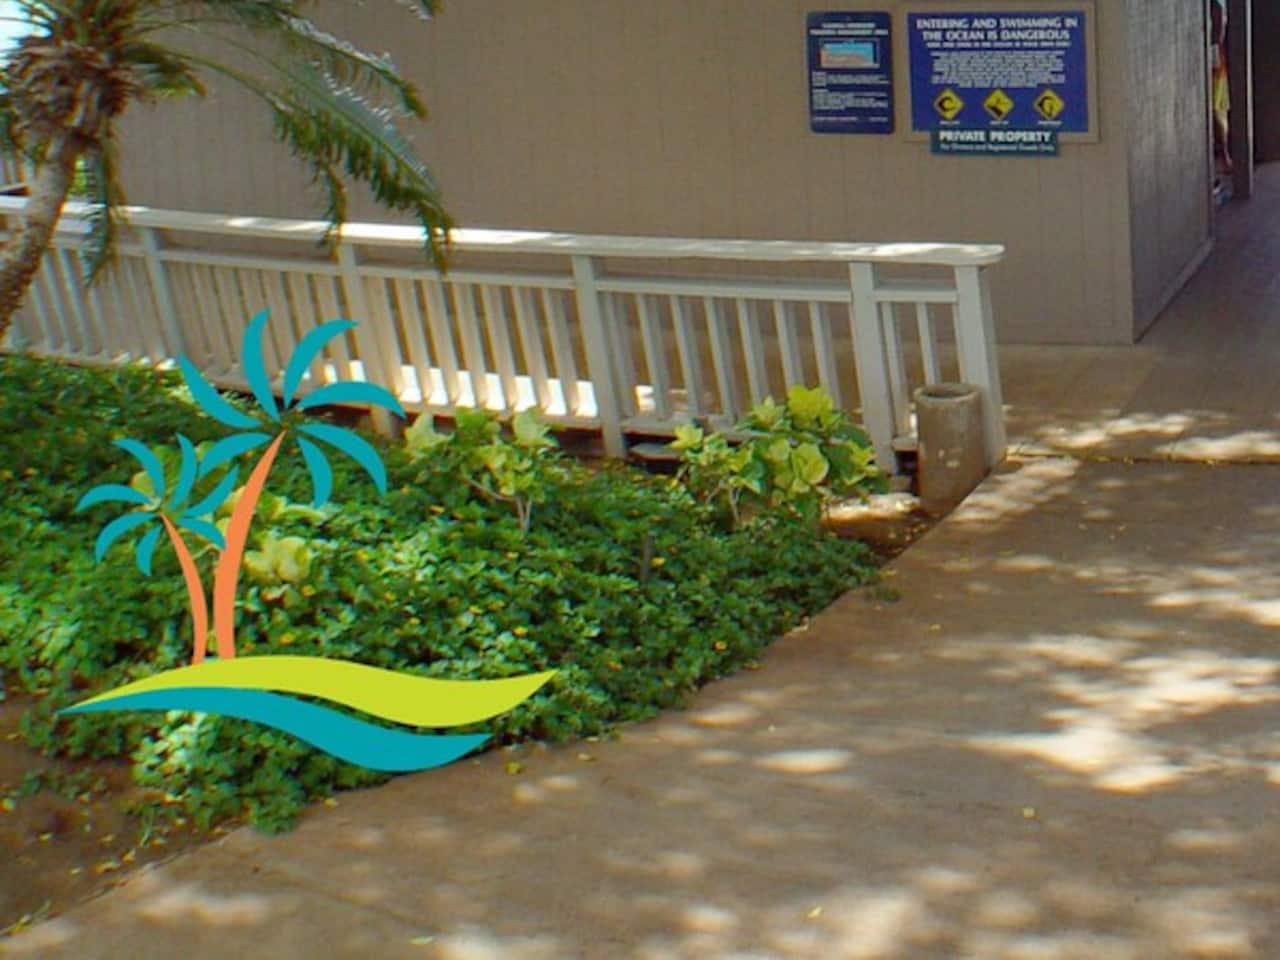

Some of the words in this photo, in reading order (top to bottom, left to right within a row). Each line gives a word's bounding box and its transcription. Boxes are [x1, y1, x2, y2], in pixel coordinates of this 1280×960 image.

[916, 19, 969, 29] ENTERING
[972, 18, 997, 29] AND
[1000, 17, 1062, 28] SWIMMING
[1065, 18, 1078, 28] IN
[923, 30, 942, 40] THE
[946, 30, 985, 40] OCEAN
[987, 30, 998, 40] IS
[1001, 30, 1071, 40] DANGEROUS
[939, 131, 985, 142] PRIVATE
[990, 131, 1052, 142] PROPERTY
